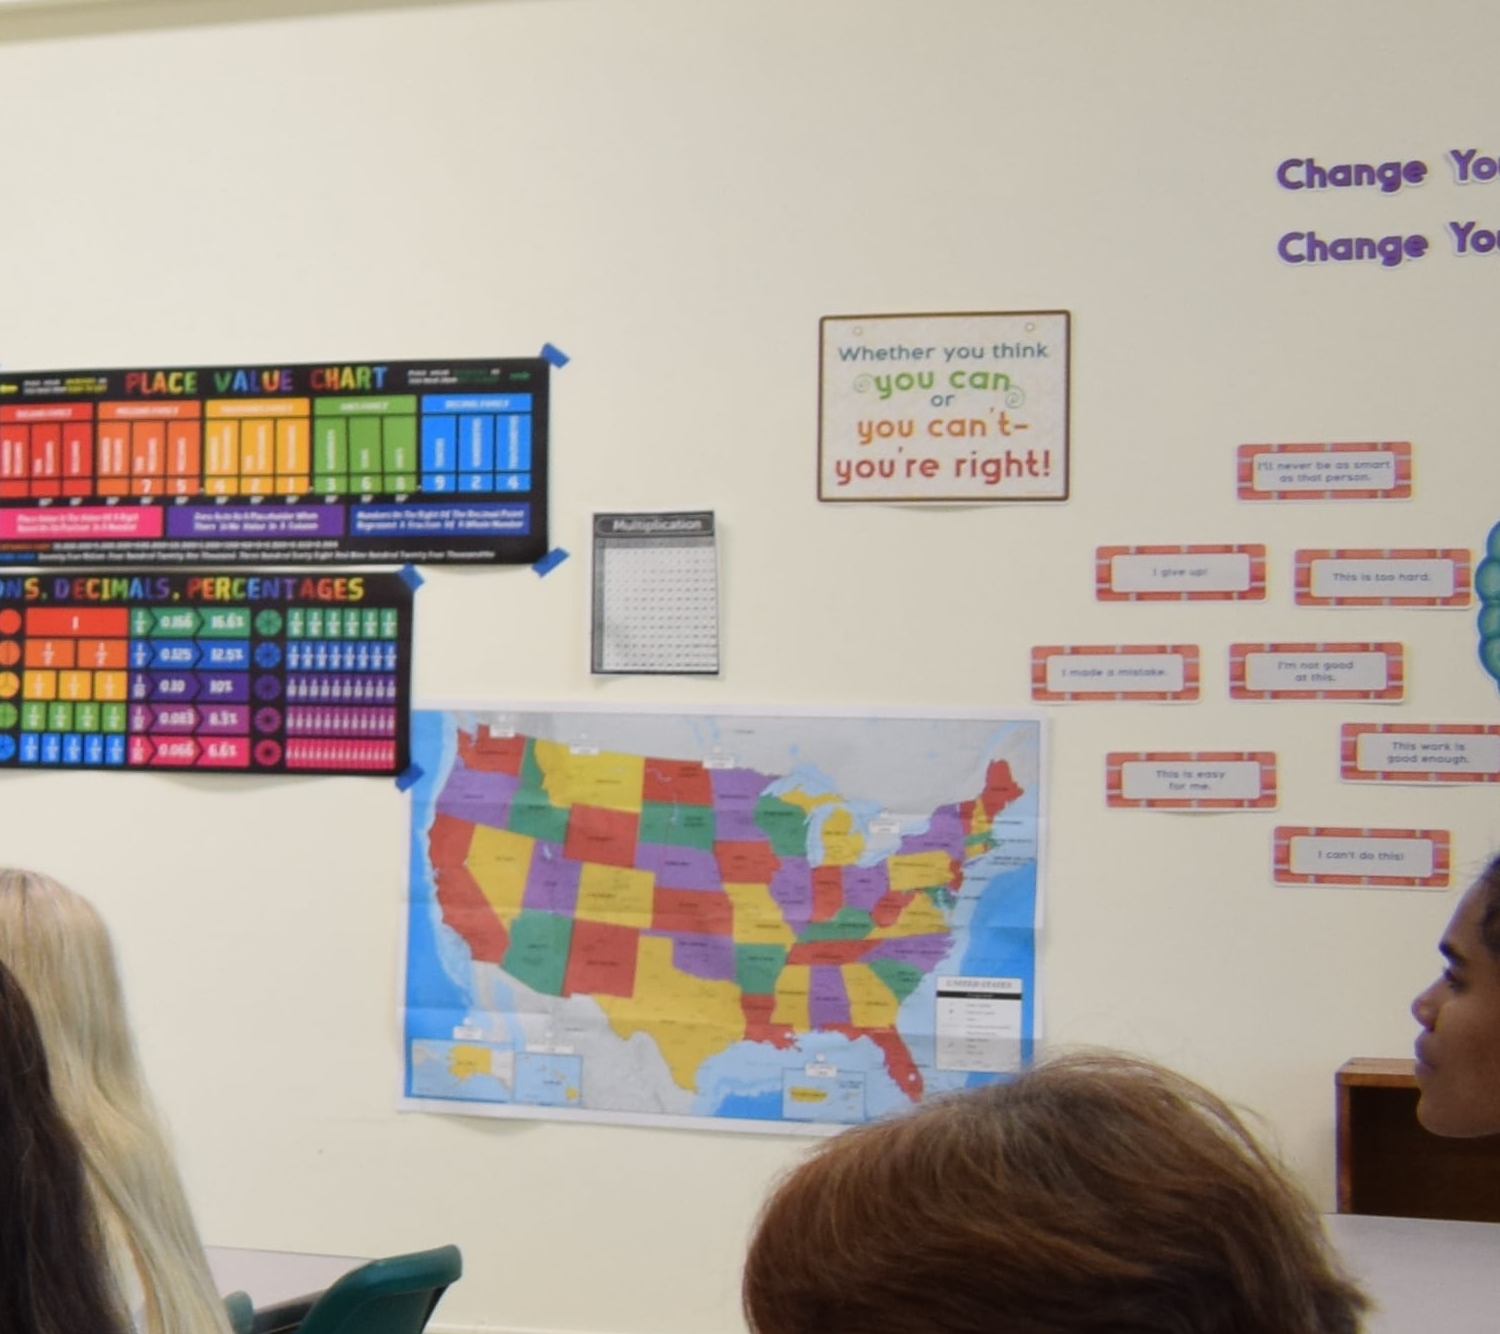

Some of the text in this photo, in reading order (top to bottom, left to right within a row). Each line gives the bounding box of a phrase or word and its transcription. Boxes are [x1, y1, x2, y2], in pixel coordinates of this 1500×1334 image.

[1277, 149, 1500, 193] Change Yo
[1278, 221, 1500, 267] Change Yo
[838, 342, 1047, 362] Whether you think
[125, 371, 198, 395] PLACE
[213, 369, 293, 393] VALUE
[310, 366, 387, 392] CHART
[874, 370, 1011, 400] you can
[930, 394, 955, 407] or
[857, 419, 914, 445] you
[836, 446, 1051, 486] you're right!
[1354, 460, 1390, 469] smart
[1297, 473, 1321, 482] that
[613, 520, 702, 532] Multiplication
[1161, 569, 1186, 578] give
[1333, 572, 1431, 581] This is too hard.
[187, 577, 364, 601] PERCENTAGES
[1300, 661, 1319, 669] not
[1323, 661, 1354, 671] good
[1070, 668, 1103, 676] made
[1295, 674, 1307, 682] at
[1392, 741, 1465, 751] This work is
[1387, 755, 1417, 764] good
[1156, 770, 1225, 779] This is easy
[1169, 782, 1185, 790] for
[1326, 851, 1355, 859] can't
[1360, 851, 1374, 860] do
